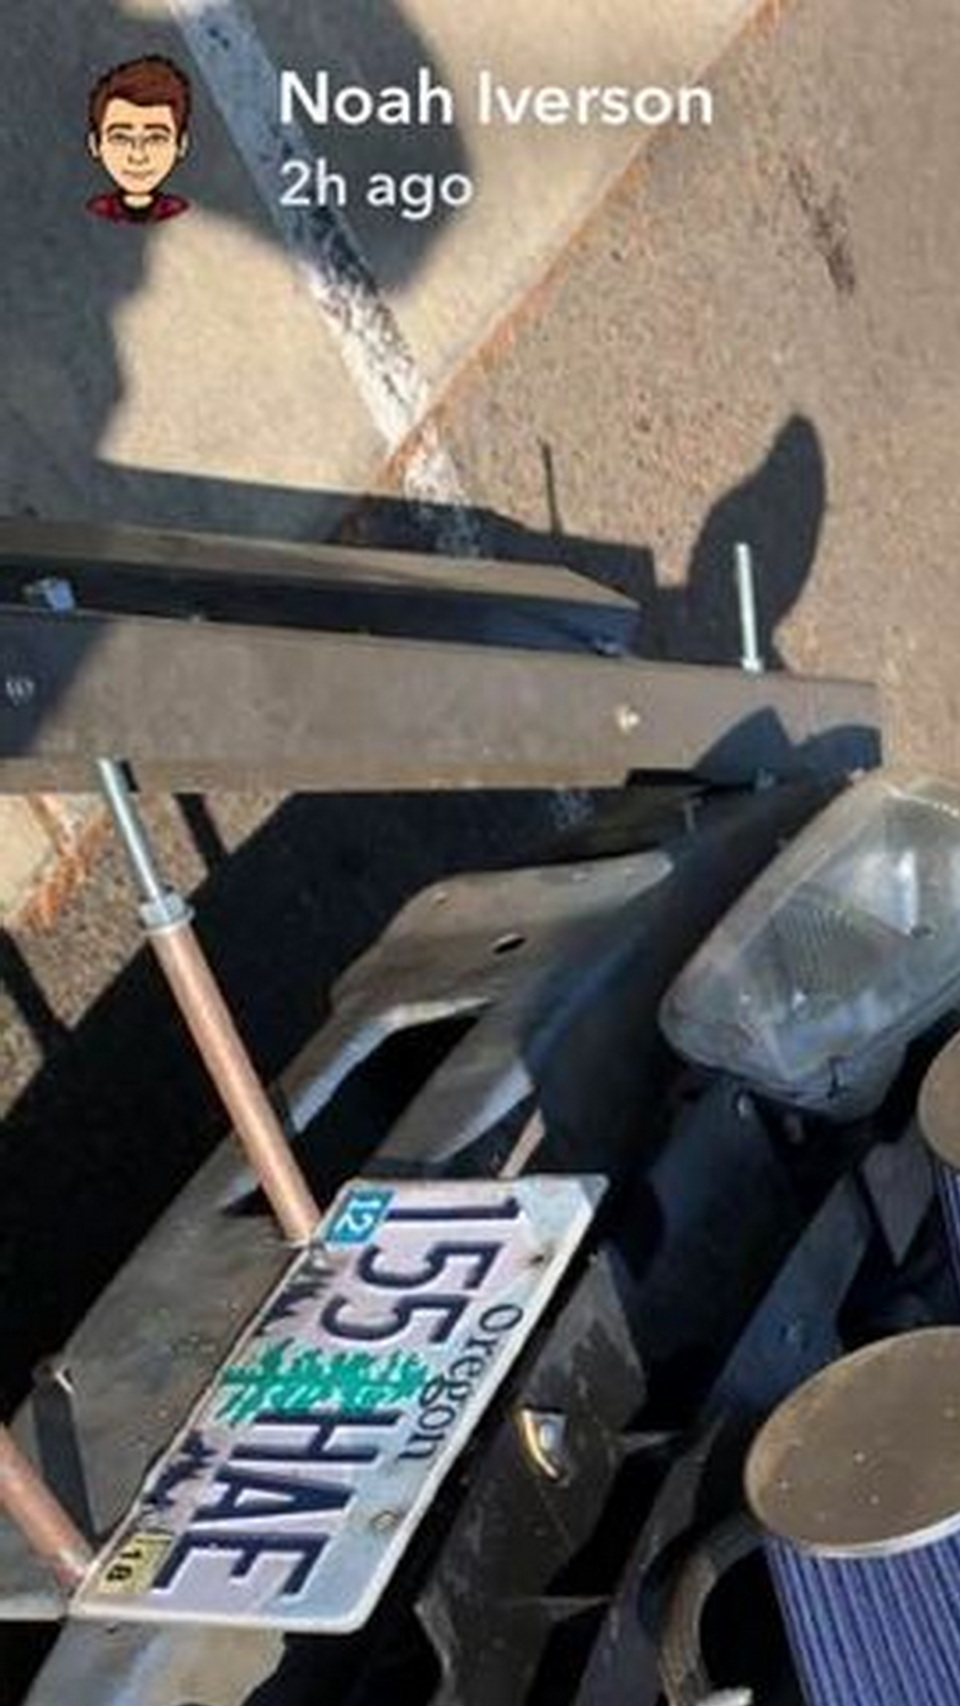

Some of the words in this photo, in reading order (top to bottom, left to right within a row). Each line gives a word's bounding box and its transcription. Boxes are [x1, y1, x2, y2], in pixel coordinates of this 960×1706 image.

[321, 1197, 520, 1346] 155
[334, 1198, 381, 1235] 12
[400, 1302, 524, 1462] Oregon
[153, 1408, 403, 1597] HAE
